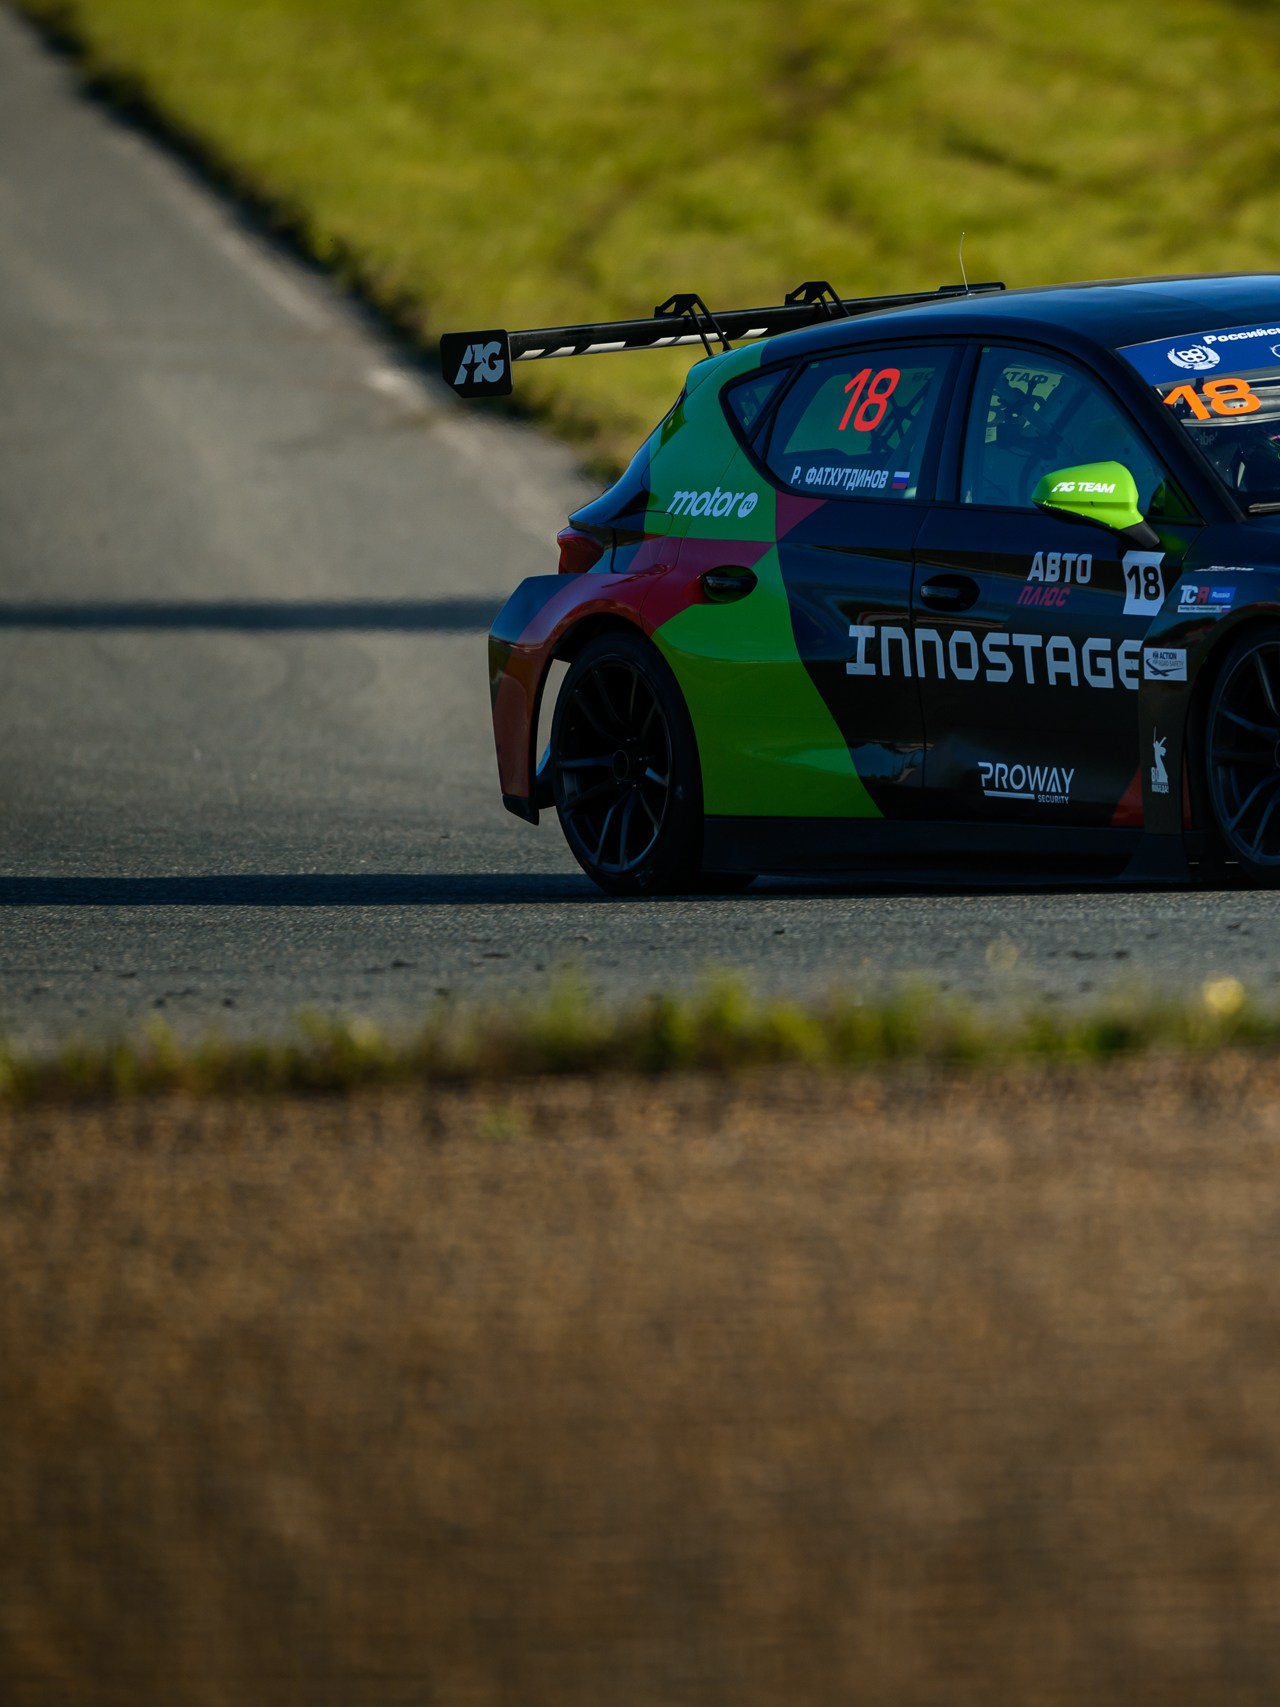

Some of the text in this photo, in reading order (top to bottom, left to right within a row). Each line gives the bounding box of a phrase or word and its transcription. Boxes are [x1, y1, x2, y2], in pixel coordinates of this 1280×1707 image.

[837, 367, 901, 432] 18
[1162, 377, 1261, 420] 18
[790, 465, 889, 491] Р. ФАТХУТДИНОВ
[1078, 481, 1117, 494] TEAM
[1026, 551, 1093, 584] АВТО
[1127, 565, 1161, 601] 18
[1016, 585, 1071, 608] ПЛЮС
[1180, 585, 1210, 605] TCR
[845, 624, 1144, 691] INNOSTAGE
[977, 761, 1075, 794] PROWAY
[1037, 794, 1070, 805] SECURITY
